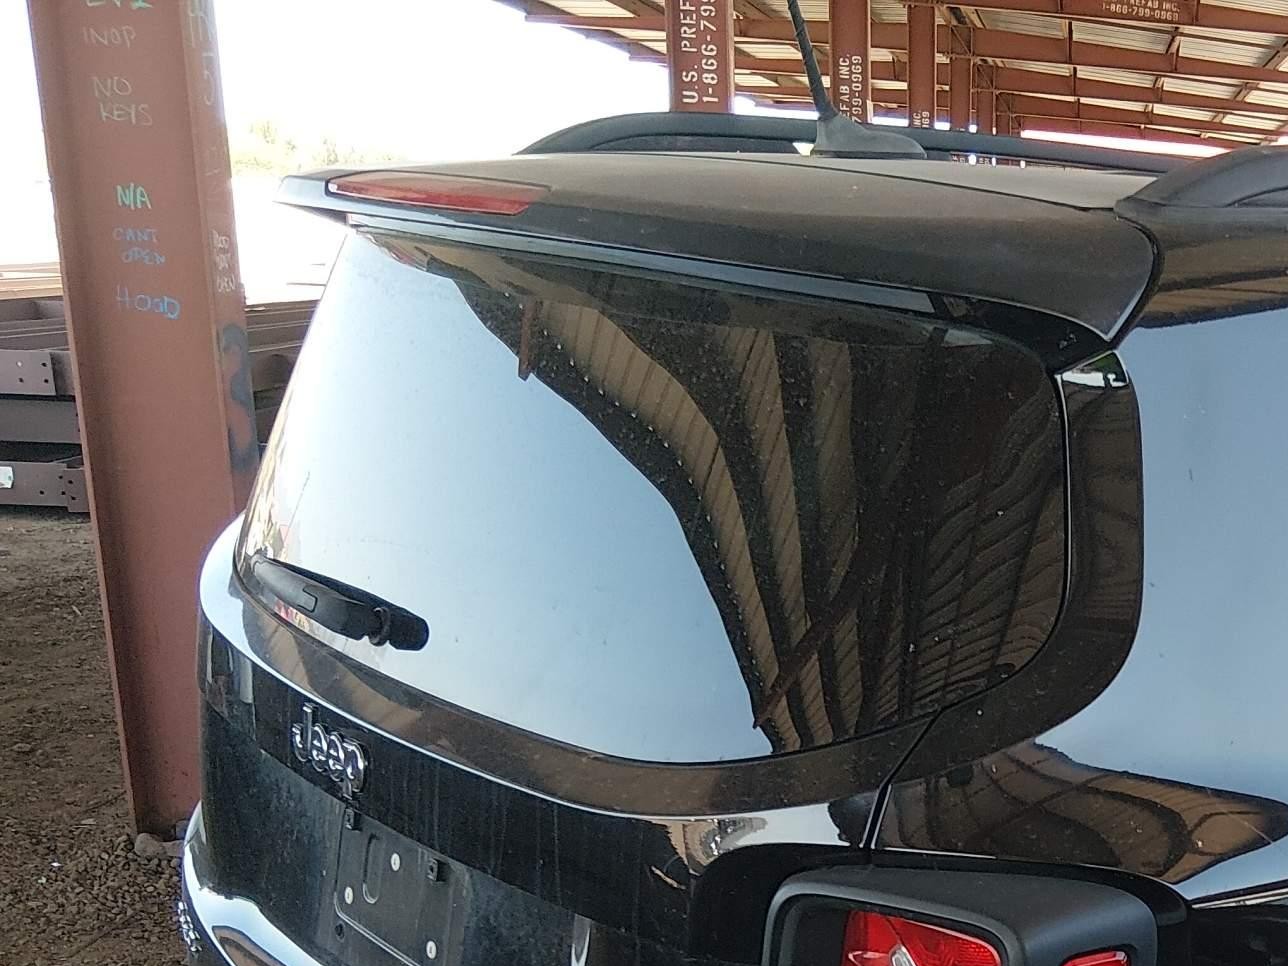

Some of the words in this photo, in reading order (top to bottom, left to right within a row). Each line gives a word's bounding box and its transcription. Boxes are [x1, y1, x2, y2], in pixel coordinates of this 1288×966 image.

[700, 0, 719, 103] 1-866-79
[92, 76, 133, 98] NO
[681, 64, 699, 104] U.S.
[99, 102, 153, 126] KEYS
[116, 181, 153, 211] N/A
[115, 284, 182, 320] HOOD
[291, 702, 365, 800] Jeep
